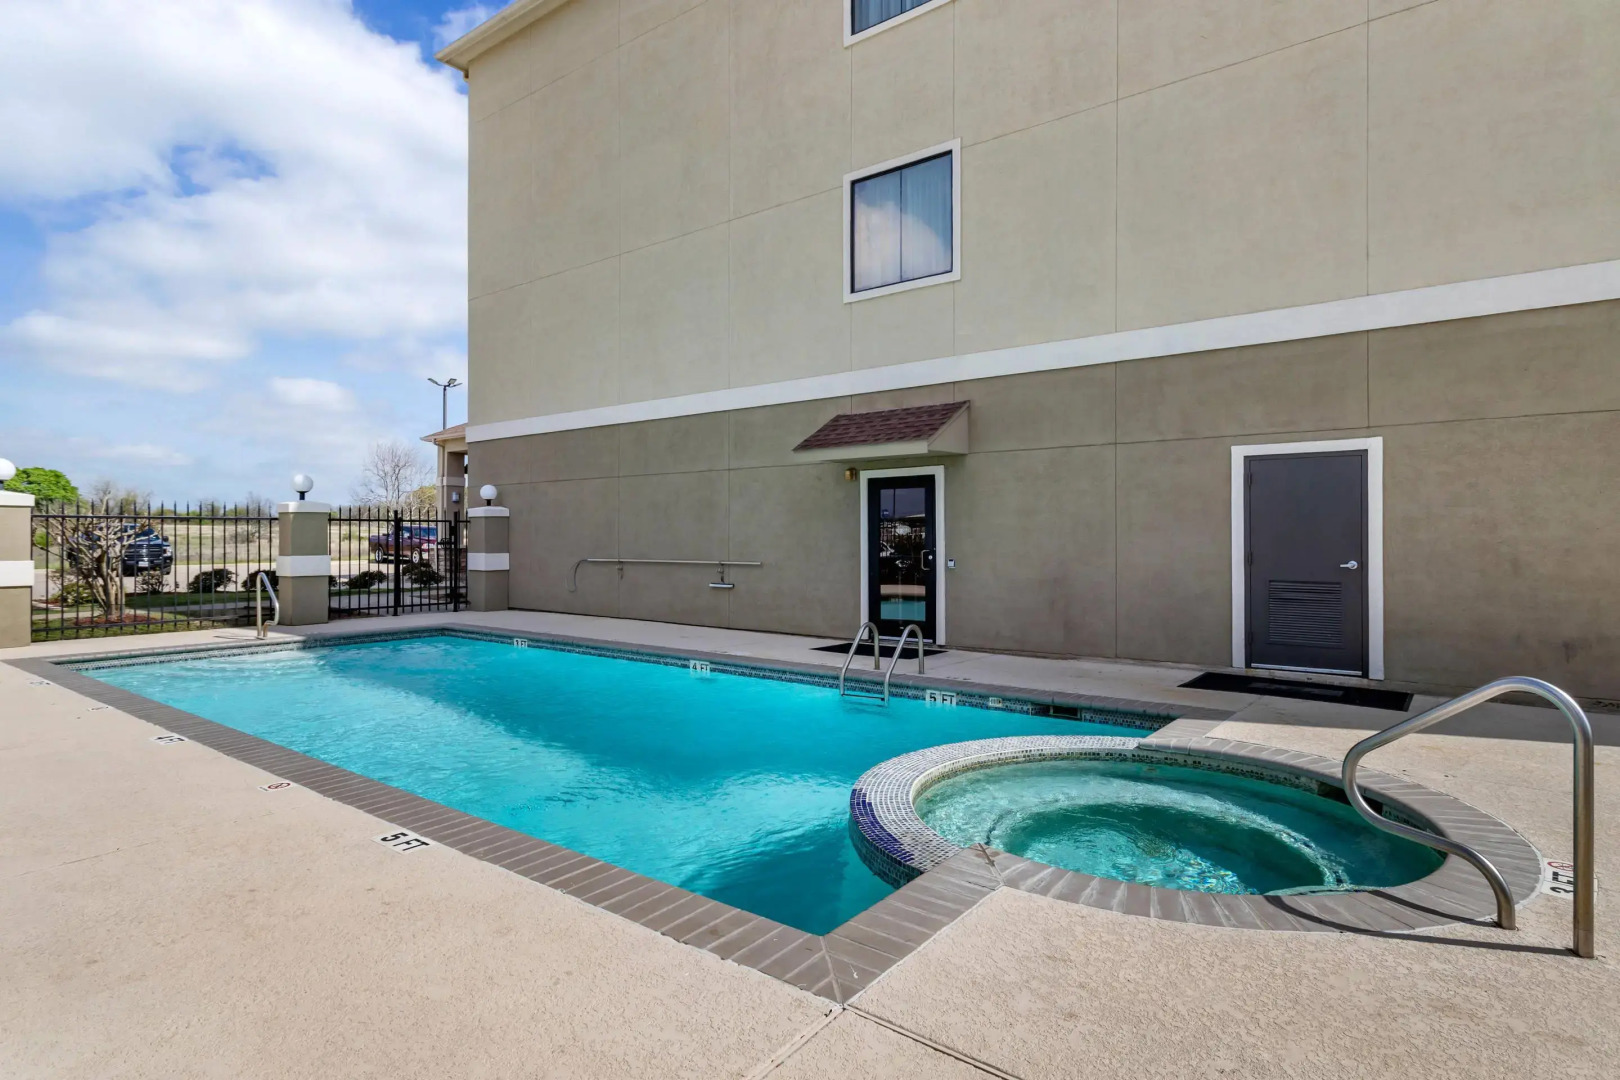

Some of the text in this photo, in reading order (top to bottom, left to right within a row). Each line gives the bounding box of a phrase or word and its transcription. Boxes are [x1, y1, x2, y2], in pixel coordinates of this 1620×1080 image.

[700, 663, 709, 671] FT
[929, 692, 955, 704] 5 FT
[380, 832, 430, 851] 5 FT
